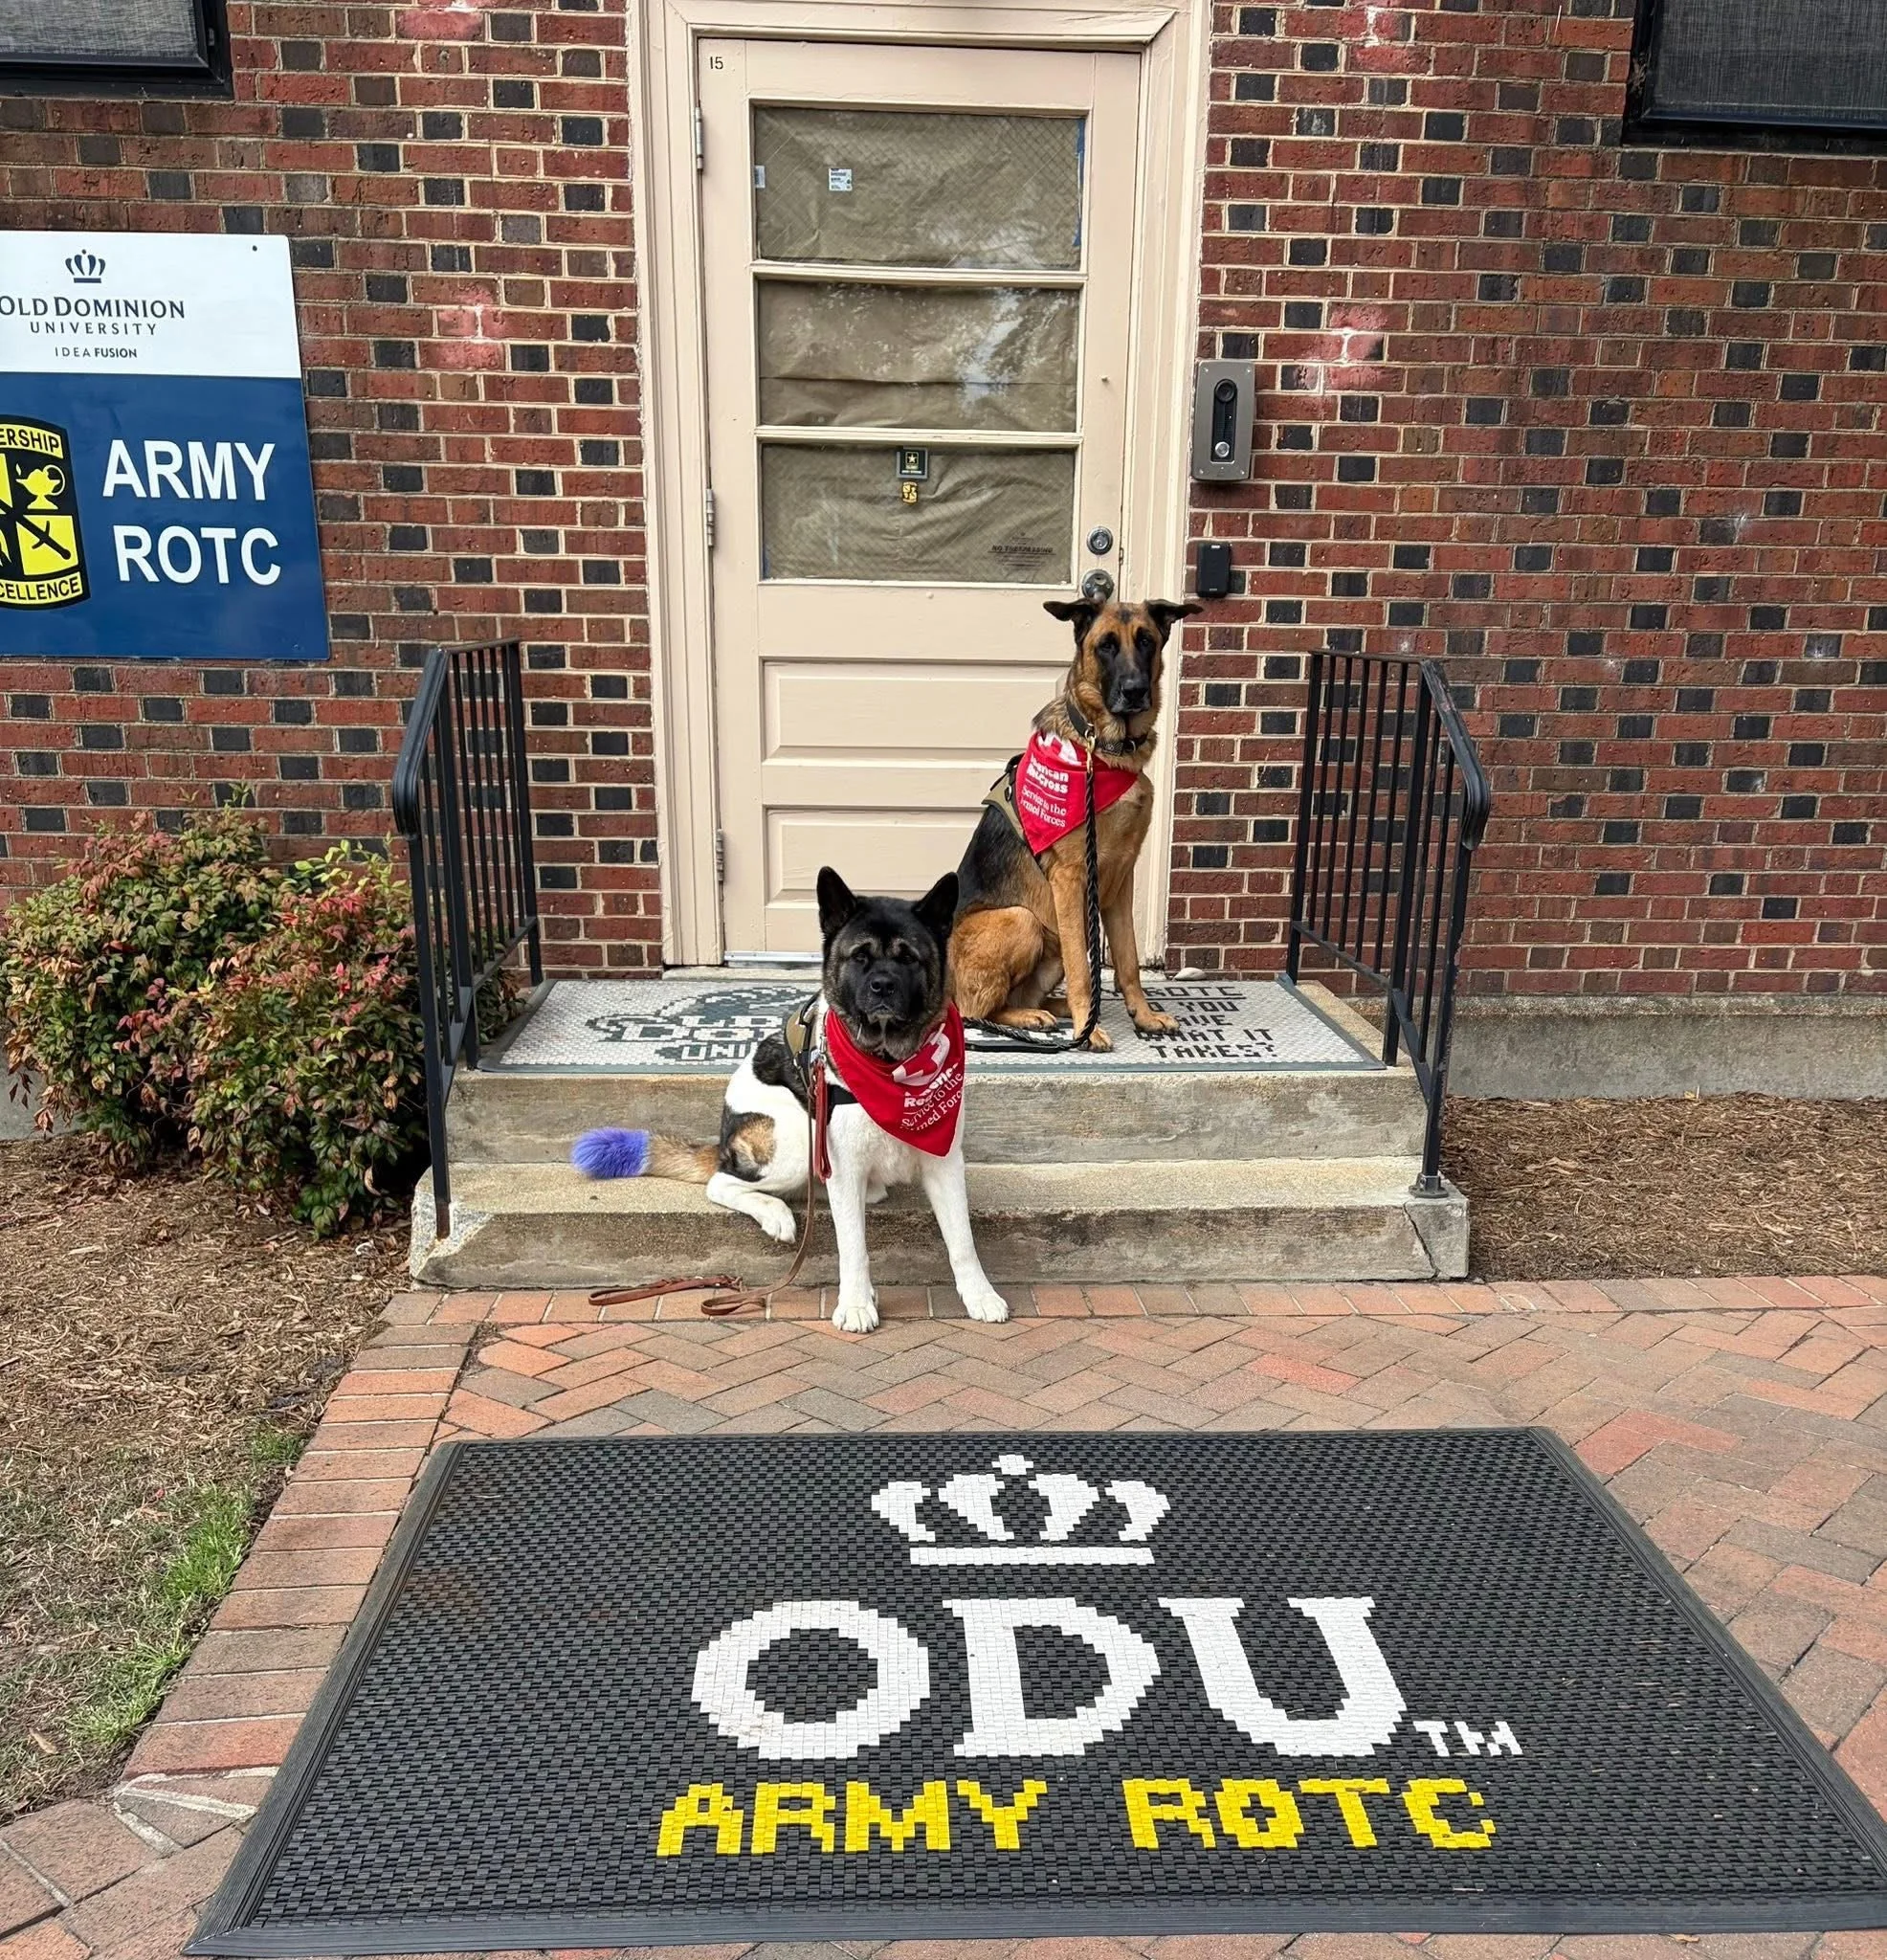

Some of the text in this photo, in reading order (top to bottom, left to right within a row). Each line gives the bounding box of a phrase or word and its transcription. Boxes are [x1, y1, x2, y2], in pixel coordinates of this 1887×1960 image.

[709, 56, 723, 70] 15
[0, 295, 185, 319] OLD DOMINION
[30, 321, 157, 336] UNIVERSITY
[55, 346, 138, 359] IDEA FUSION
[101, 438, 276, 501] ARMY
[112, 523, 282, 586] ROTC
[1050, 803, 1067, 816] the
[1179, 1001, 1240, 1013] YOU
[1174, 1014, 1233, 1027] AVE
[1243, 1029, 1275, 1041] IT
[944, 1073, 964, 1091] the
[938, 1090, 963, 1115] Forc
[691, 1595, 1523, 1760] ODU TM
[656, 1777, 1497, 1857] ARMY ROTC
